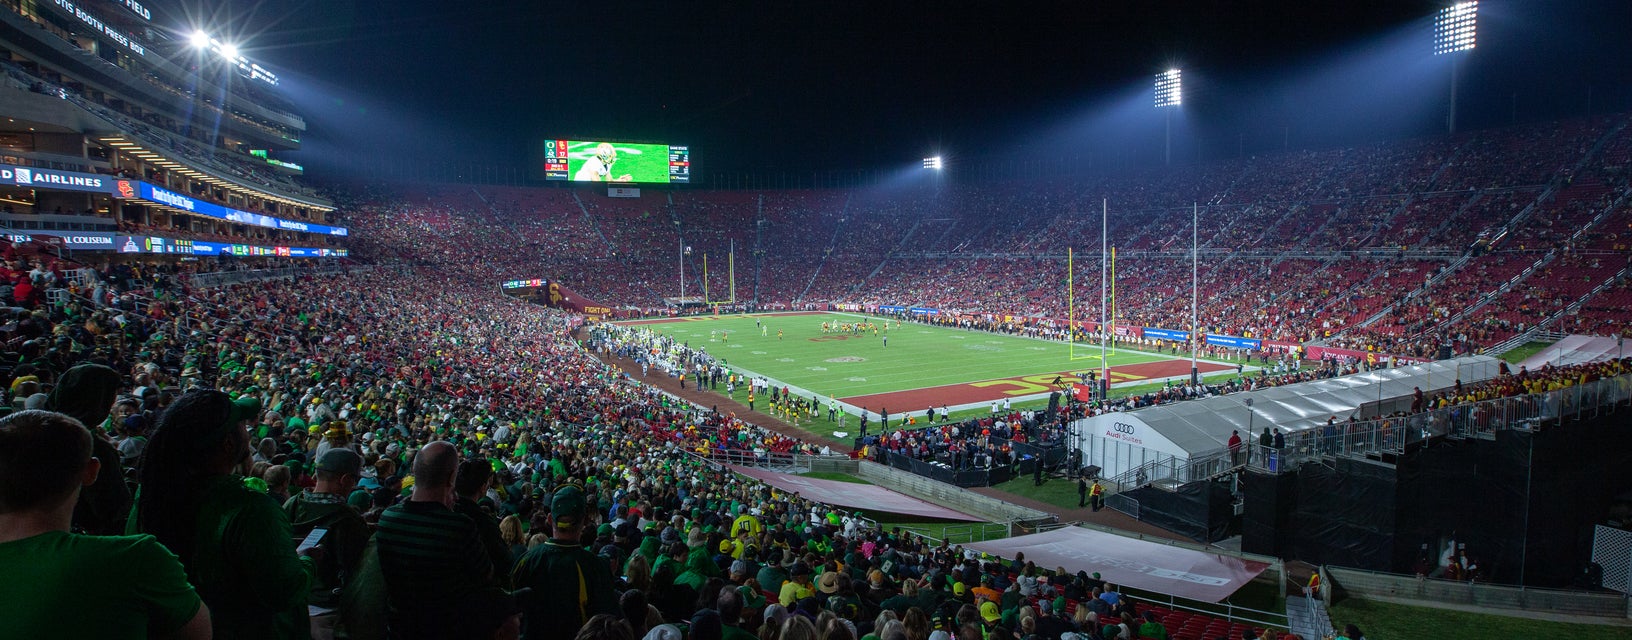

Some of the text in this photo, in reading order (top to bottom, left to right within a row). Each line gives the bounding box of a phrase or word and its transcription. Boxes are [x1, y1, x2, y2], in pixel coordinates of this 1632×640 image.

[126, 0, 151, 20] FIELD
[75, 7, 104, 32] BOOTH
[104, 26, 128, 47] PRESS
[129, 41, 145, 56] BOX
[33, 173, 102, 187] AIRLINES
[584, 306, 601, 314] FIGHT
[1105, 430, 1143, 444] Audi Suites
